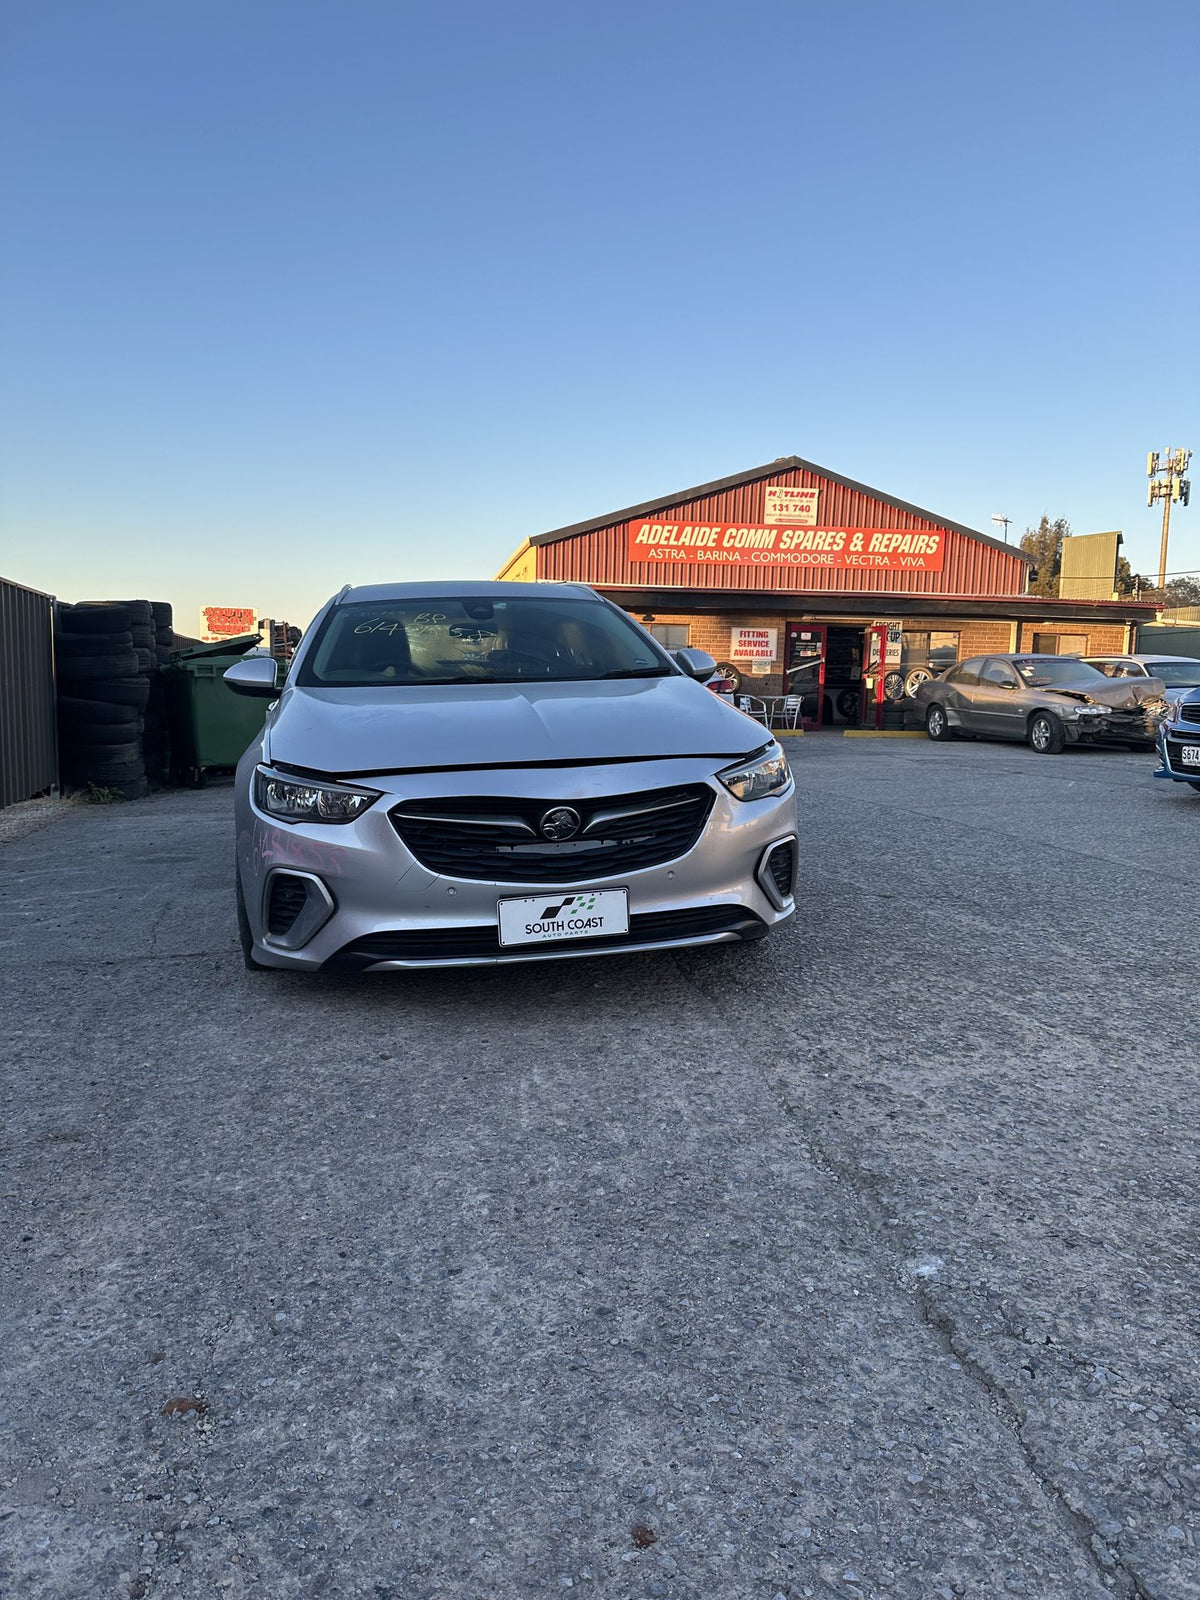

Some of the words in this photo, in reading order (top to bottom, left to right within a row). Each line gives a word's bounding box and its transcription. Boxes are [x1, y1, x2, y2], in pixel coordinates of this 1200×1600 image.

[772, 503, 789, 512] 131
[793, 504, 811, 513] 740
[635, 524, 721, 547] ADELAIDE
[722, 527, 778, 549] COMM
[779, 529, 847, 551] SPARES
[849, 532, 865, 552] &
[868, 533, 940, 554] REPAIRS
[648, 548, 687, 560] ASTRA
[697, 550, 741, 561] BARINA
[751, 552, 834, 564] COMMODORE
[845, 554, 890, 567] VECTRA
[900, 557, 925, 567] VIVA
[203, 607, 254, 617] SOUTH
[206, 615, 256, 626] COAST
[740, 630, 769, 639] FITTING
[738, 640, 770, 648] SERVICE
[733, 649, 774, 657] AVAILABLE
[525, 920, 565, 935] SOUTH
[567, 917, 604, 930] COAST
